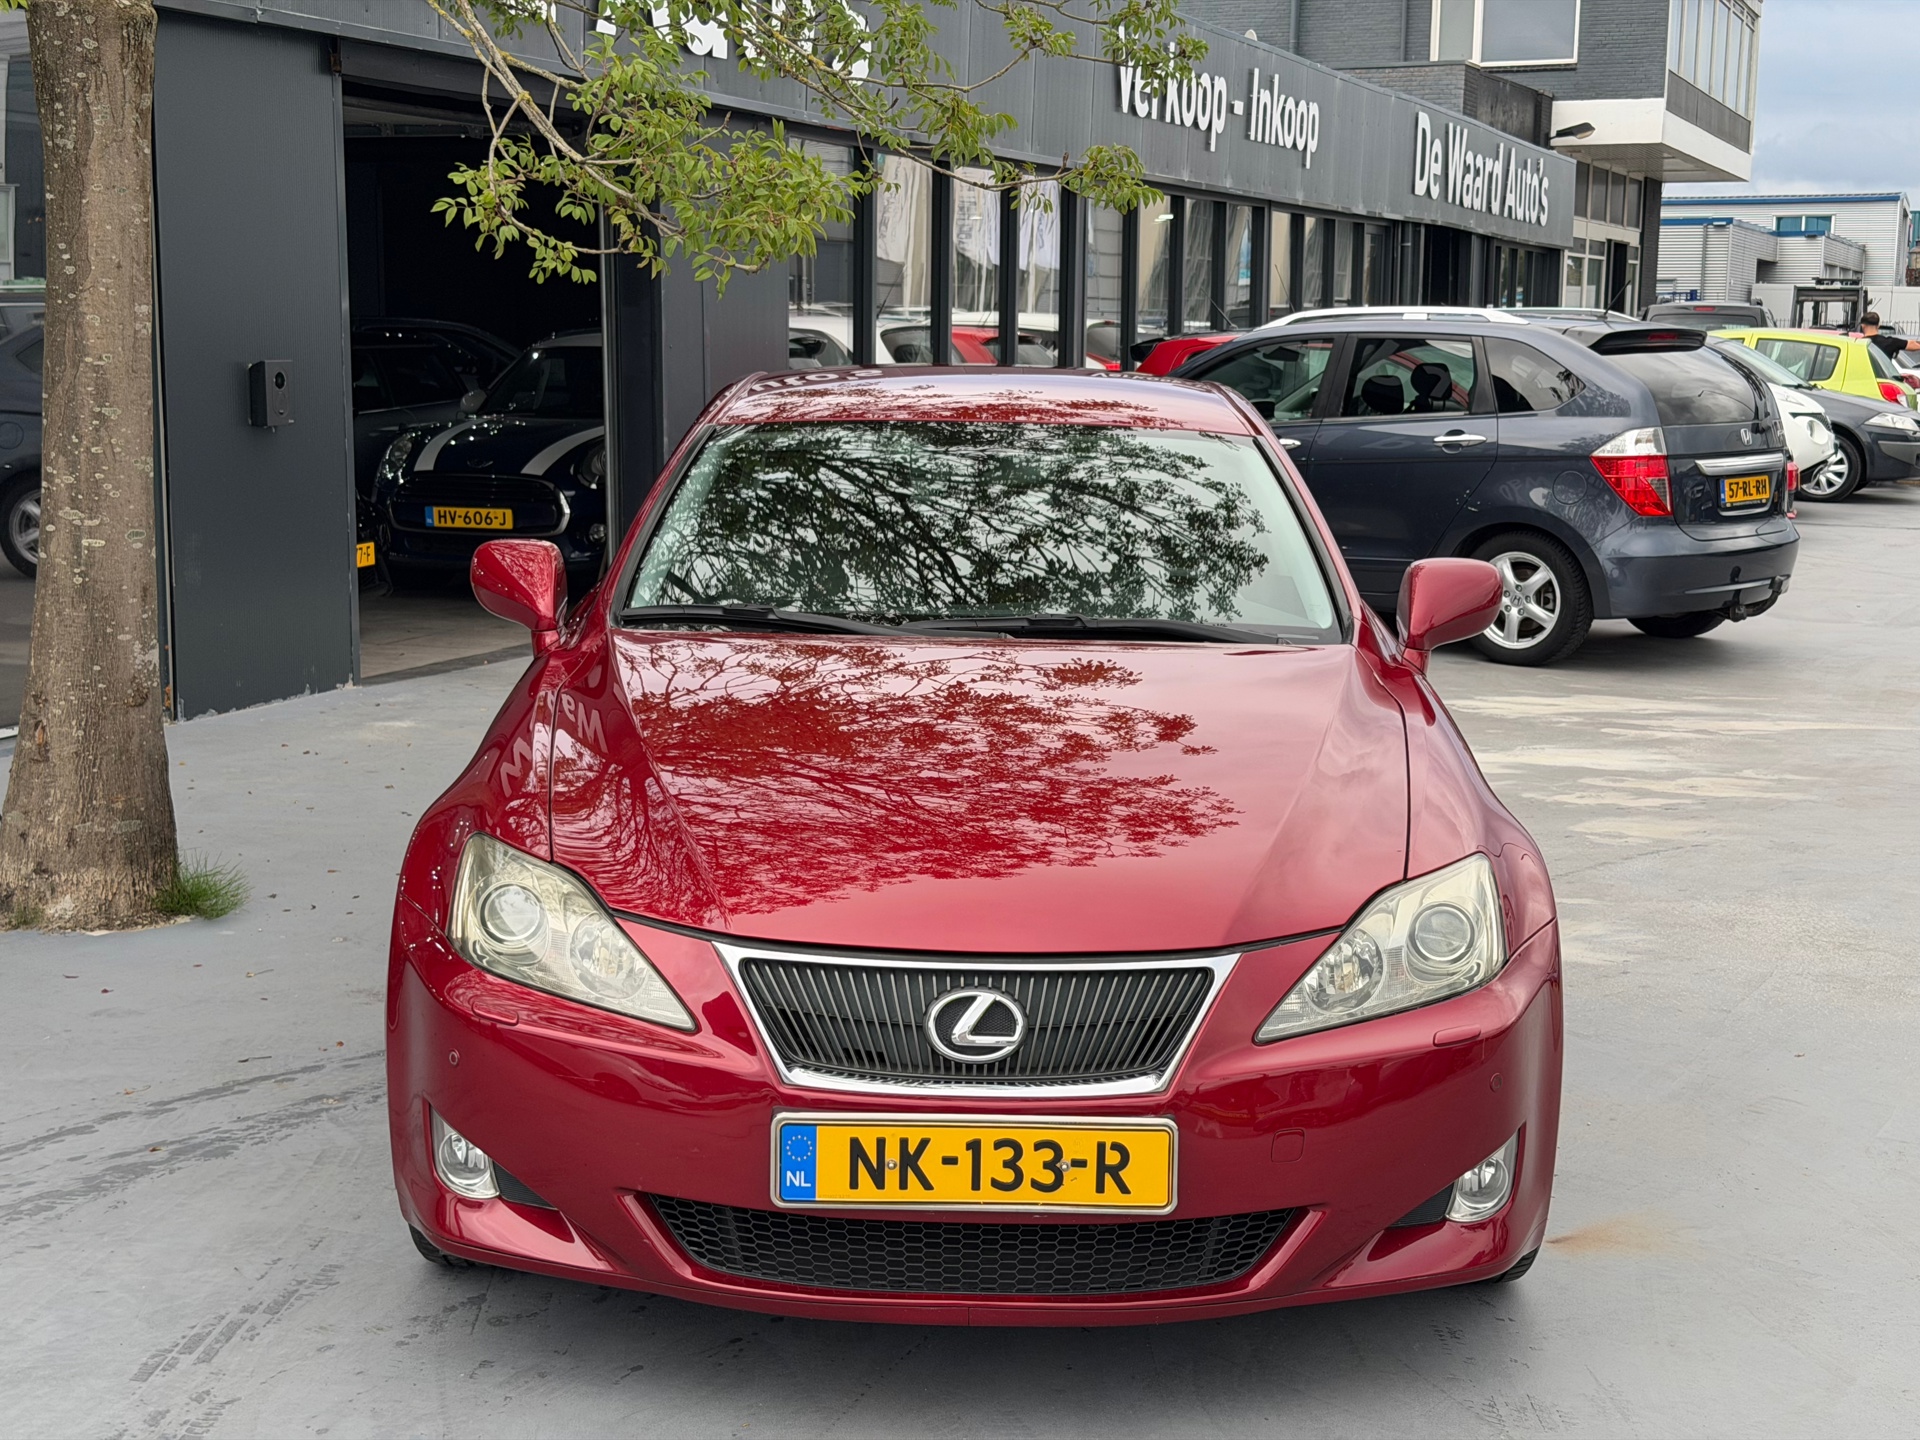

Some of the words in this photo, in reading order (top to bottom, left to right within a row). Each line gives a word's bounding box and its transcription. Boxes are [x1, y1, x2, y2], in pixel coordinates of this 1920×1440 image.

[1118, 26, 1227, 152] Verkoop
[1250, 67, 1320, 169] Inkoop
[1414, 111, 1442, 200] De
[1448, 122, 1504, 216] Waard
[1503, 147, 1549, 227] Auto's
[437, 509, 507, 526] HV-606-J
[1728, 478, 1767, 498] 57-RL-RH
[786, 1170, 812, 1187] NL
[848, 1135, 1132, 1195] NK-133-R
